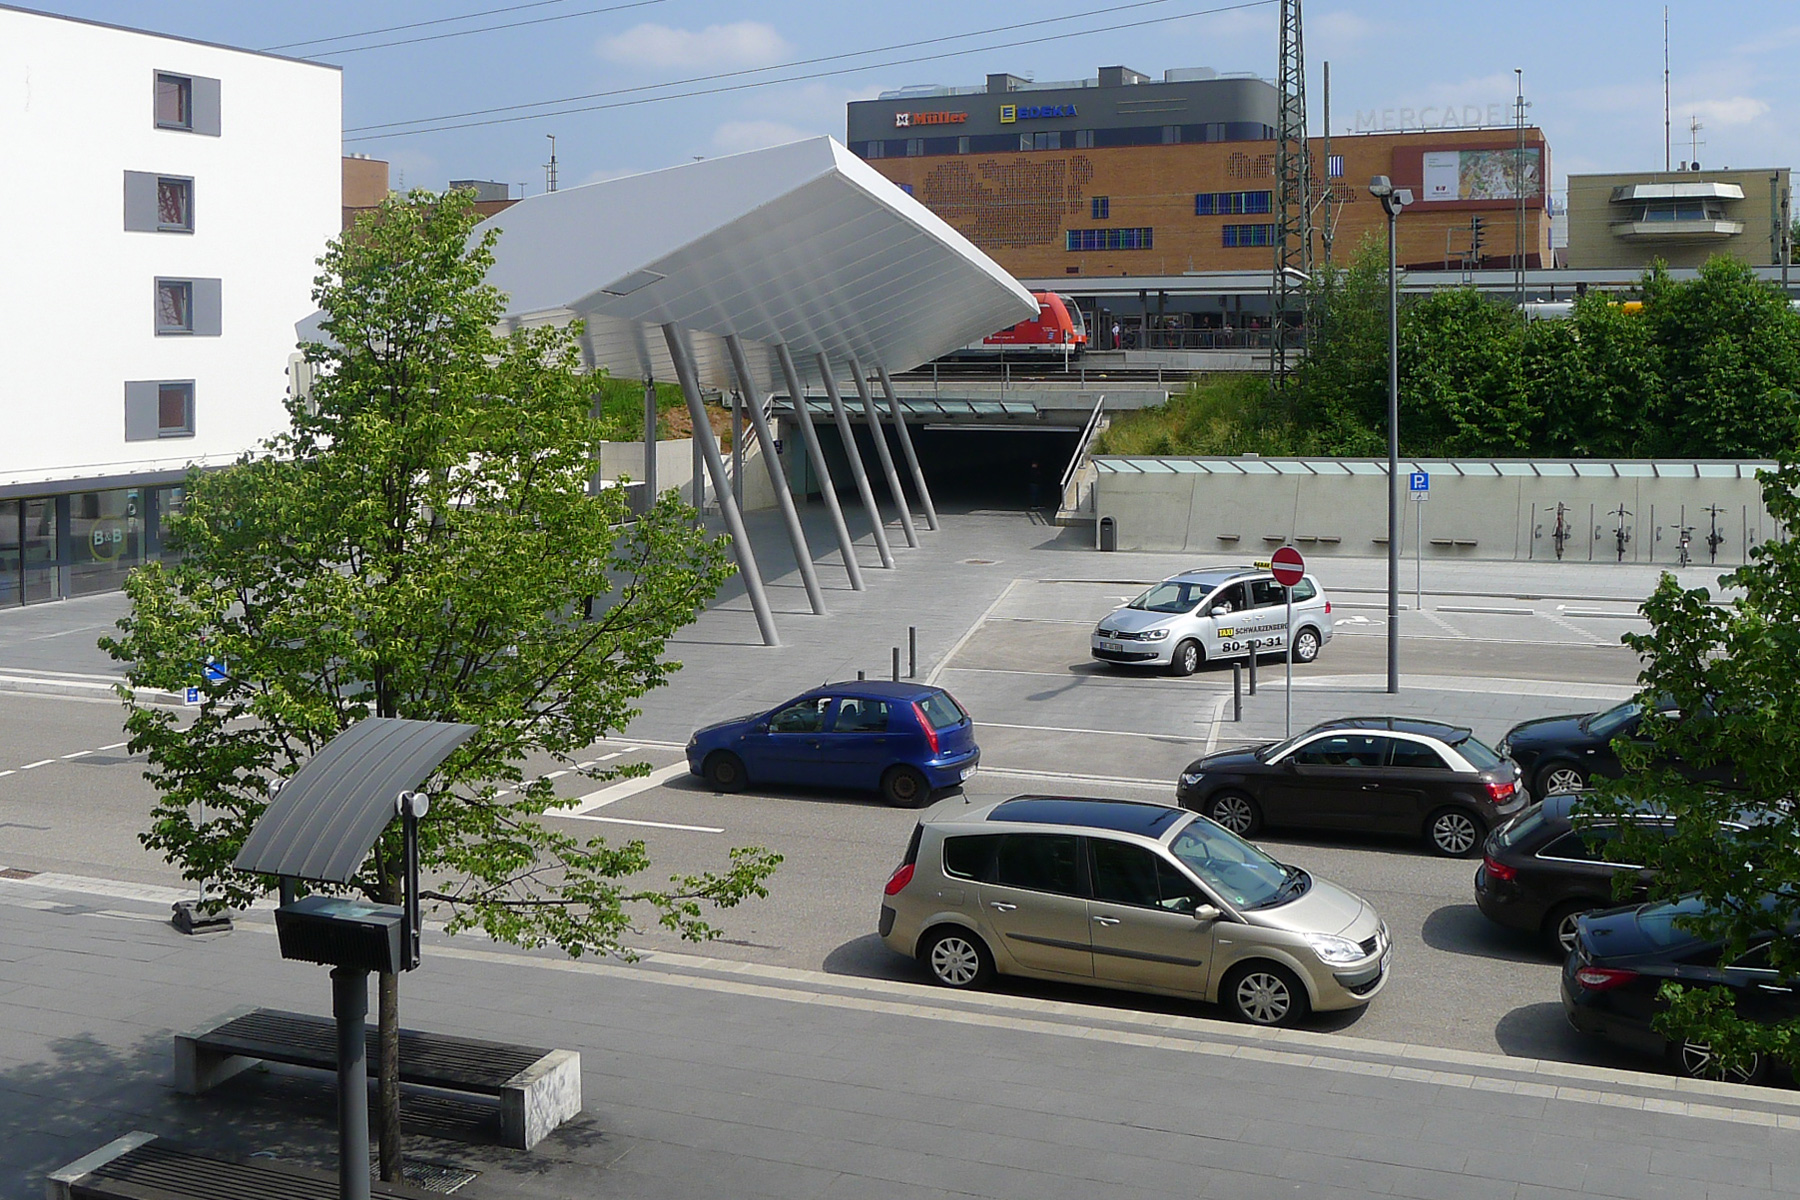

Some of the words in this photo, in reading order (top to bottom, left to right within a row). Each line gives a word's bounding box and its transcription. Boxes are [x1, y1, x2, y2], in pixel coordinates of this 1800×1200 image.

[913, 111, 968, 125] Müller
[1017, 104, 1078, 119] EDEKA
[1414, 474, 1425, 489] P
[94, 528, 123, 546] B&B
[1218, 628, 1233, 637] TAXI
